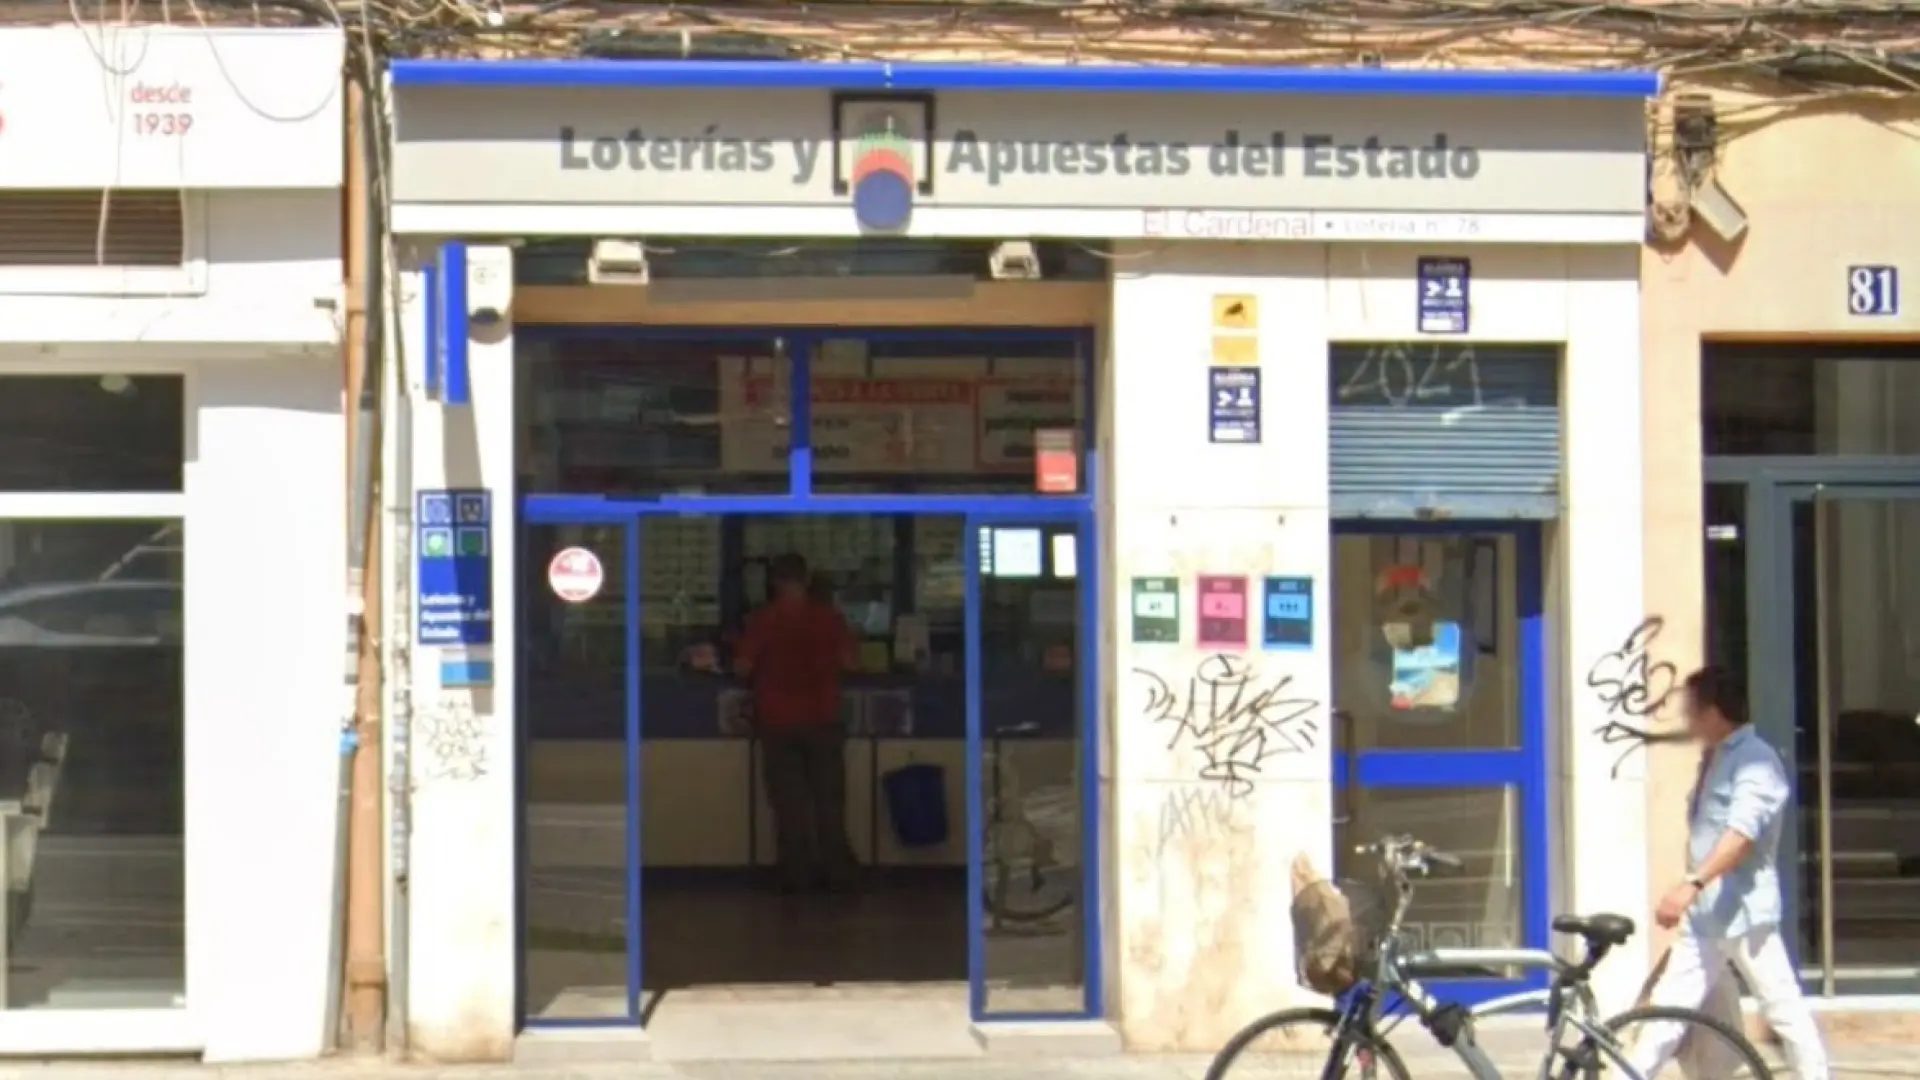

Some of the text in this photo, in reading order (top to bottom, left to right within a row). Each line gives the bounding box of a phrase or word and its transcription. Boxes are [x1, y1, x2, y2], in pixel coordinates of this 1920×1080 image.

[131, 80, 192, 103] desde
[134, 113, 194, 136] 1939
[559, 124, 1481, 186] Loterías y Apuestas del Estado
[1143, 207, 1169, 236] El
[1184, 207, 1315, 237] Cardenal
[1851, 269, 1892, 313] 81
